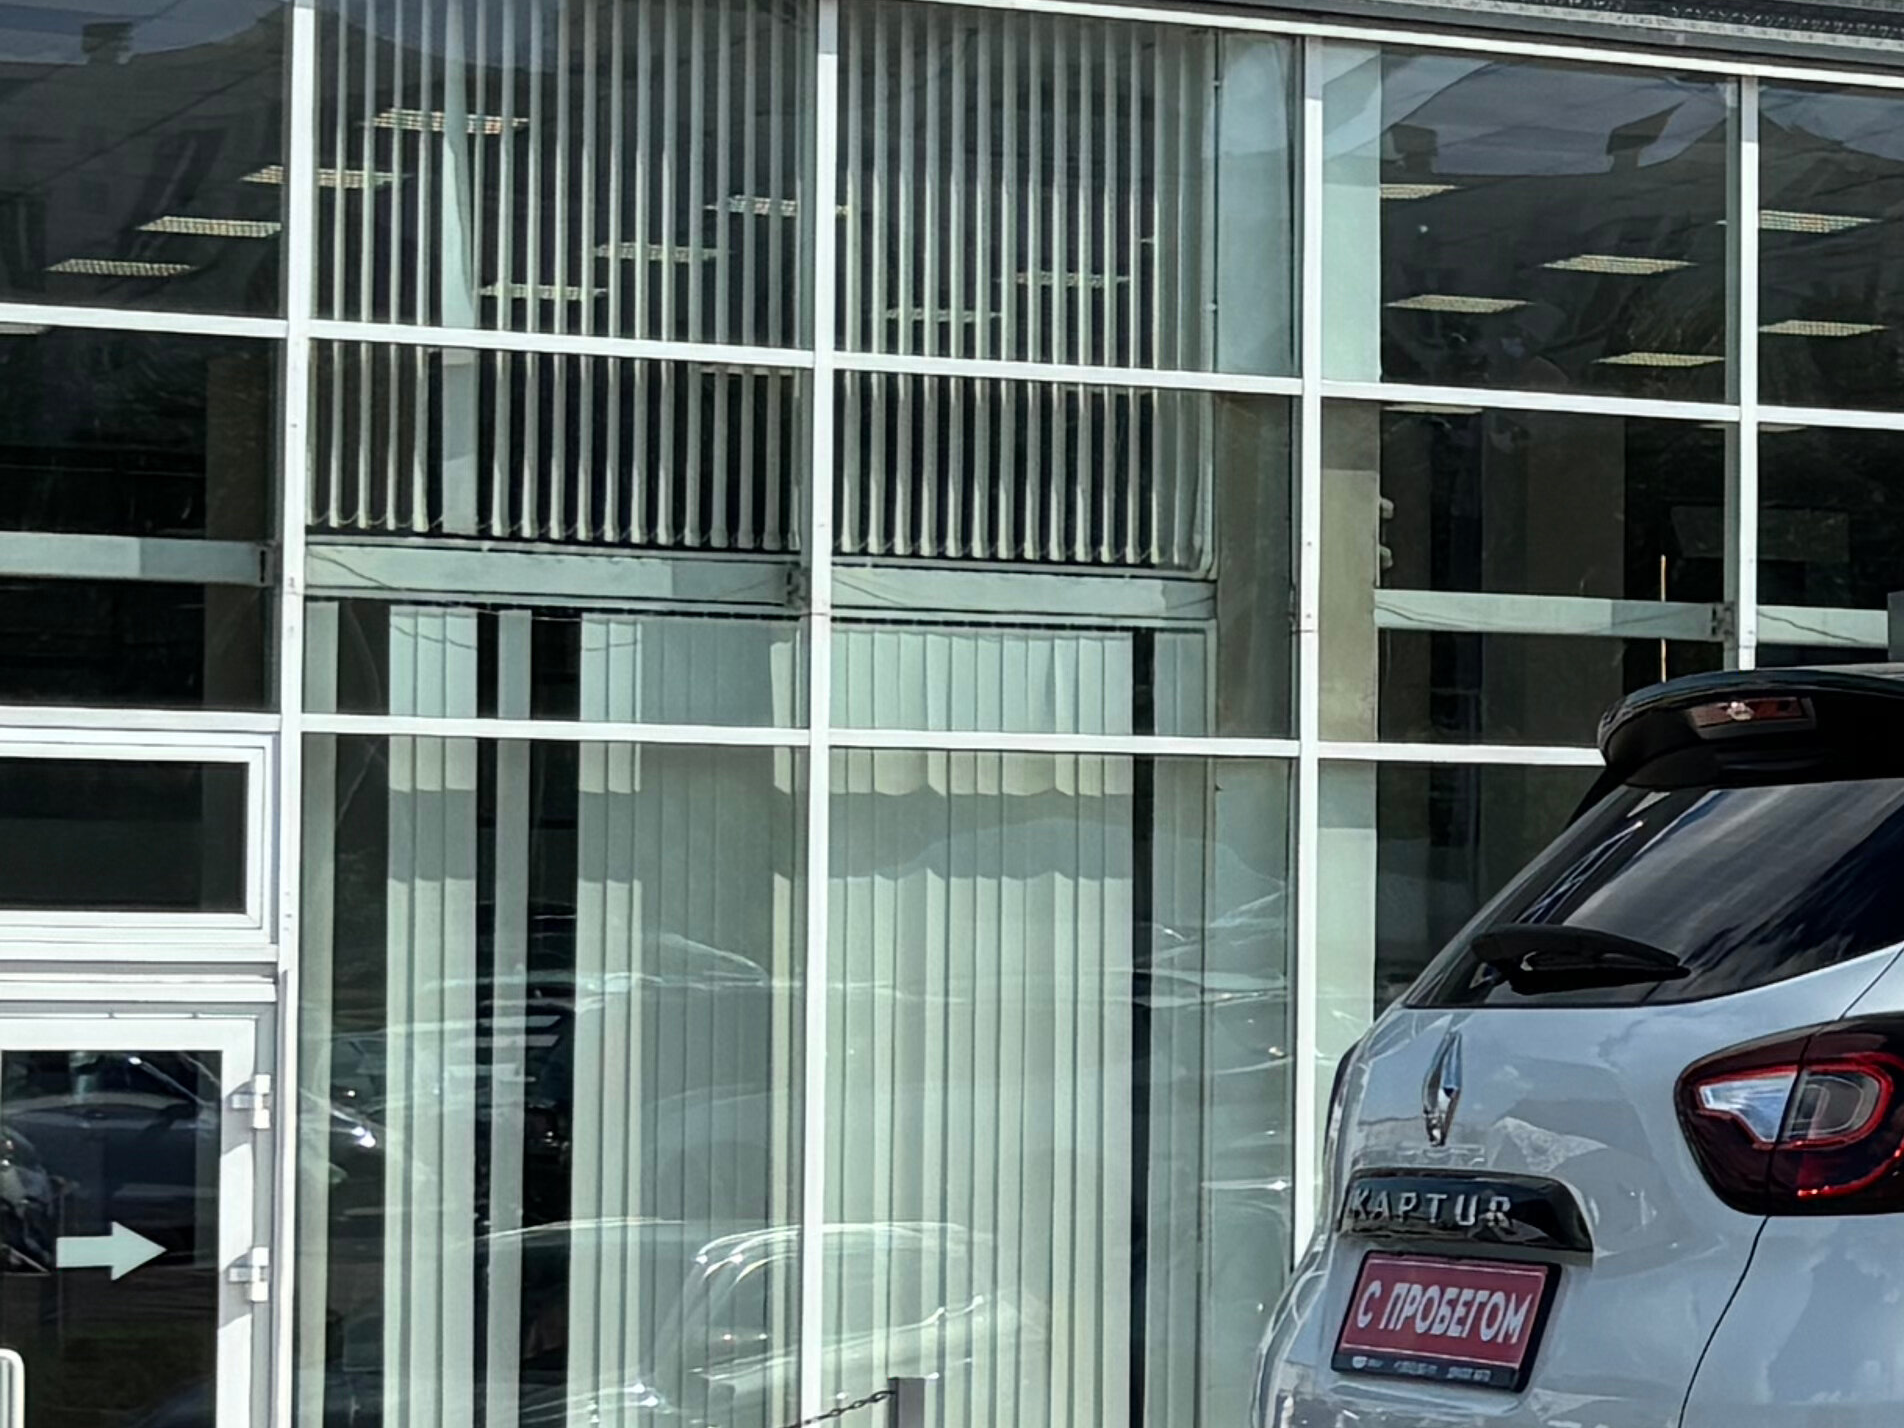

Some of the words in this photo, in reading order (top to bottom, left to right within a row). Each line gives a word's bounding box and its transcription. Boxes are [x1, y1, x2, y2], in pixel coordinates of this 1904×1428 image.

[1350, 1186, 1512, 1229] KAPTUR
[1356, 1280, 1382, 1328] С
[1379, 1282, 1532, 1344] ПРОБЕГОМ
